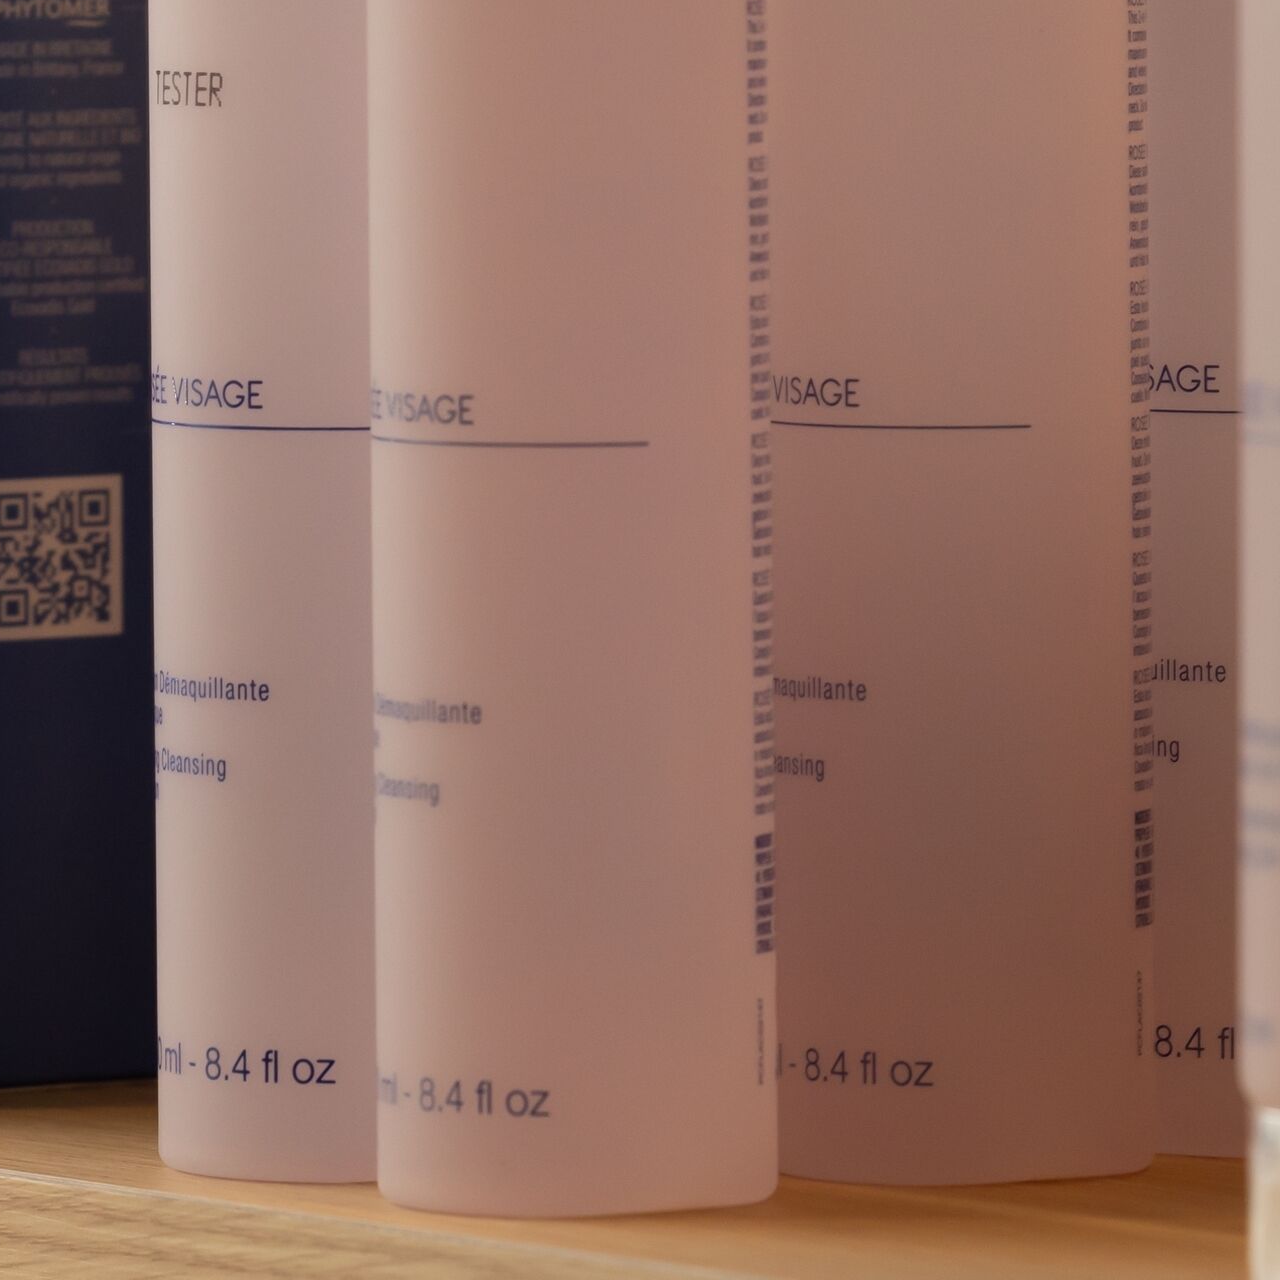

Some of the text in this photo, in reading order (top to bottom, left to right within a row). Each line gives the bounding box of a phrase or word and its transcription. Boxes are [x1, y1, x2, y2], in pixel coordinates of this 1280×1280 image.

[156, 70, 223, 107] TESTER
[172, 377, 264, 410] VISAGE
[385, 391, 475, 425] VISAGE
[773, 375, 860, 408] VISAGE
[159, 670, 270, 702] Démaquillante
[161, 747, 227, 782] Cleansing
[1155, 1025, 1205, 1058] 8.4
[1218, 1027, 1235, 1060] fl
[164, 1042, 182, 1075] ml
[205, 1047, 251, 1082] 8.4
[261, 1050, 279, 1084] fl
[292, 1058, 337, 1085] oz
[805, 1048, 848, 1083] 8.4
[860, 1051, 876, 1084] fl
[890, 1060, 934, 1087] oz
[420, 1077, 464, 1113] 8.4
[475, 1080, 493, 1115] fl
[505, 1089, 550, 1118] oz
